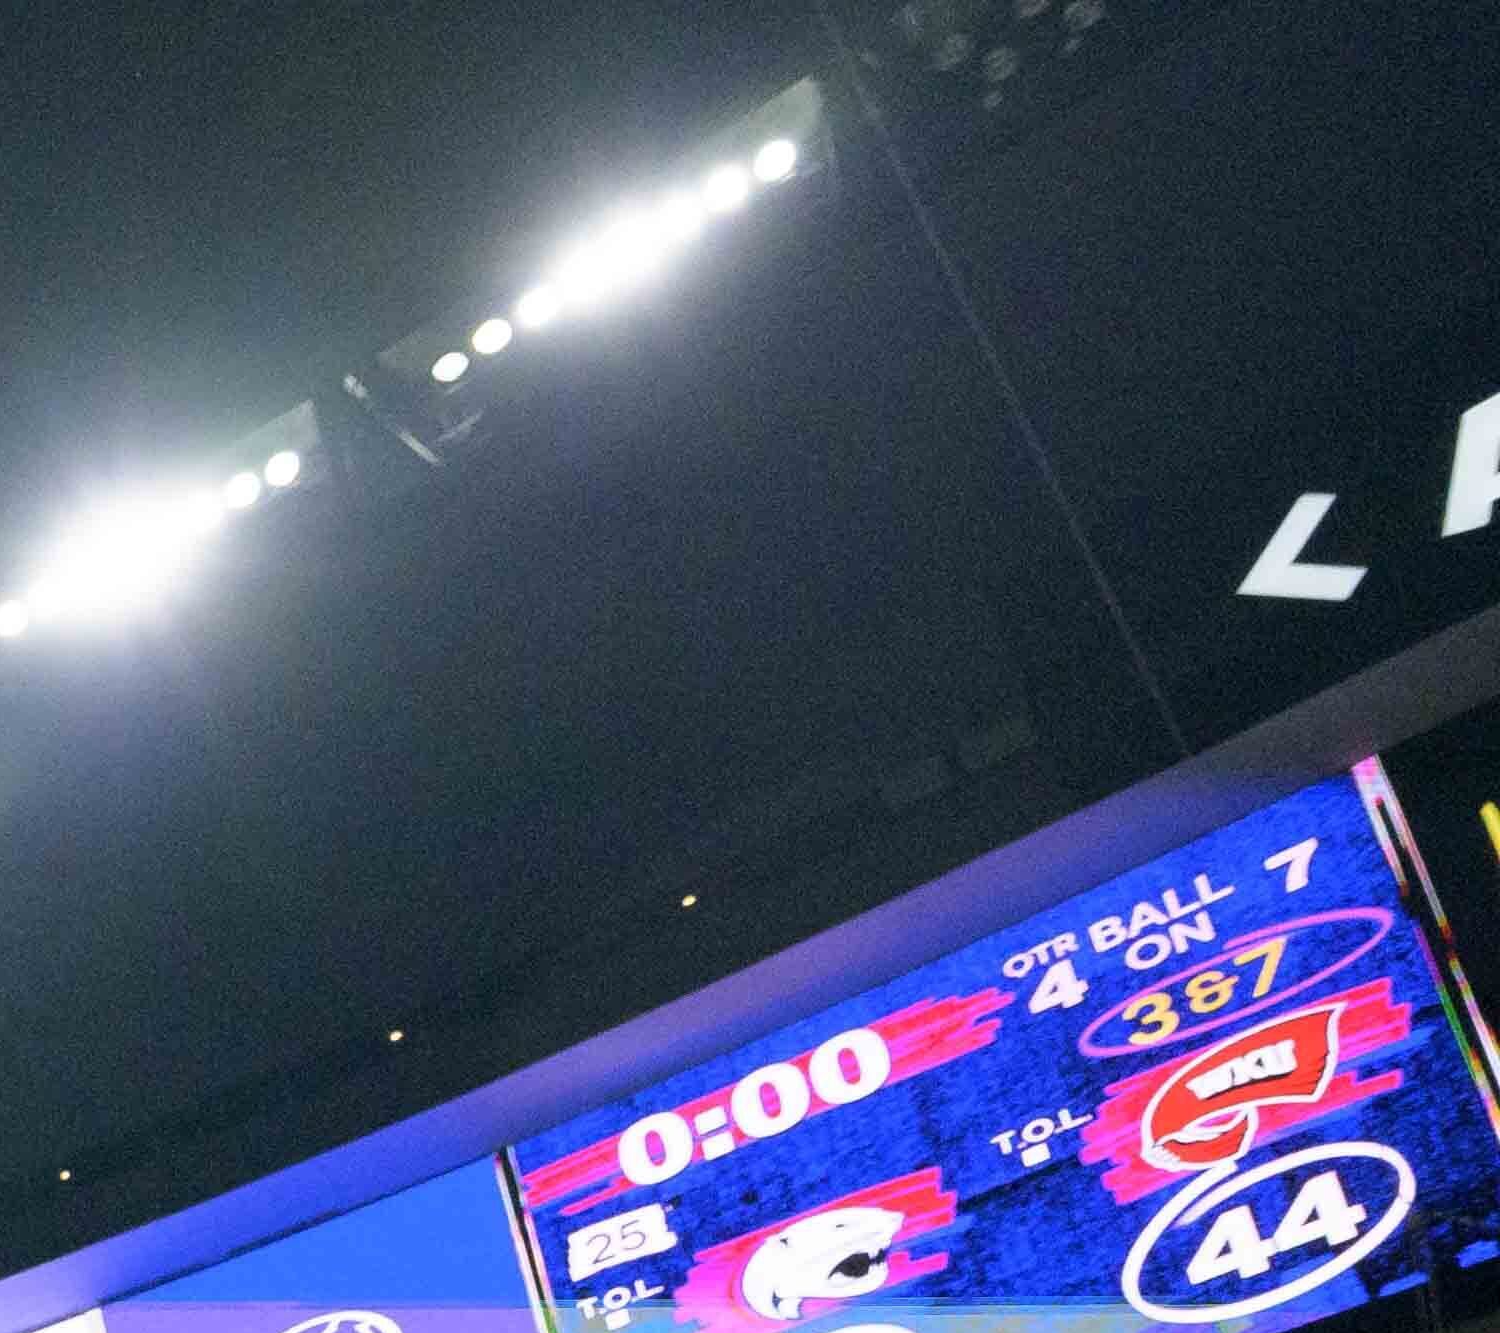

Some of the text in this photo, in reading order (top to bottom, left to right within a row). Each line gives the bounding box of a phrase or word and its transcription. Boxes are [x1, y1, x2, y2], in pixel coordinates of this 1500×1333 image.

[1264, 837, 1319, 893] 7
[1088, 874, 1235, 953] BALL
[1124, 911, 1217, 971] ON
[1027, 959, 1088, 1015] 4
[617, 1027, 891, 1185] 0:00
[585, 1218, 648, 1266] 25
[1185, 1169, 1368, 1286] 44
